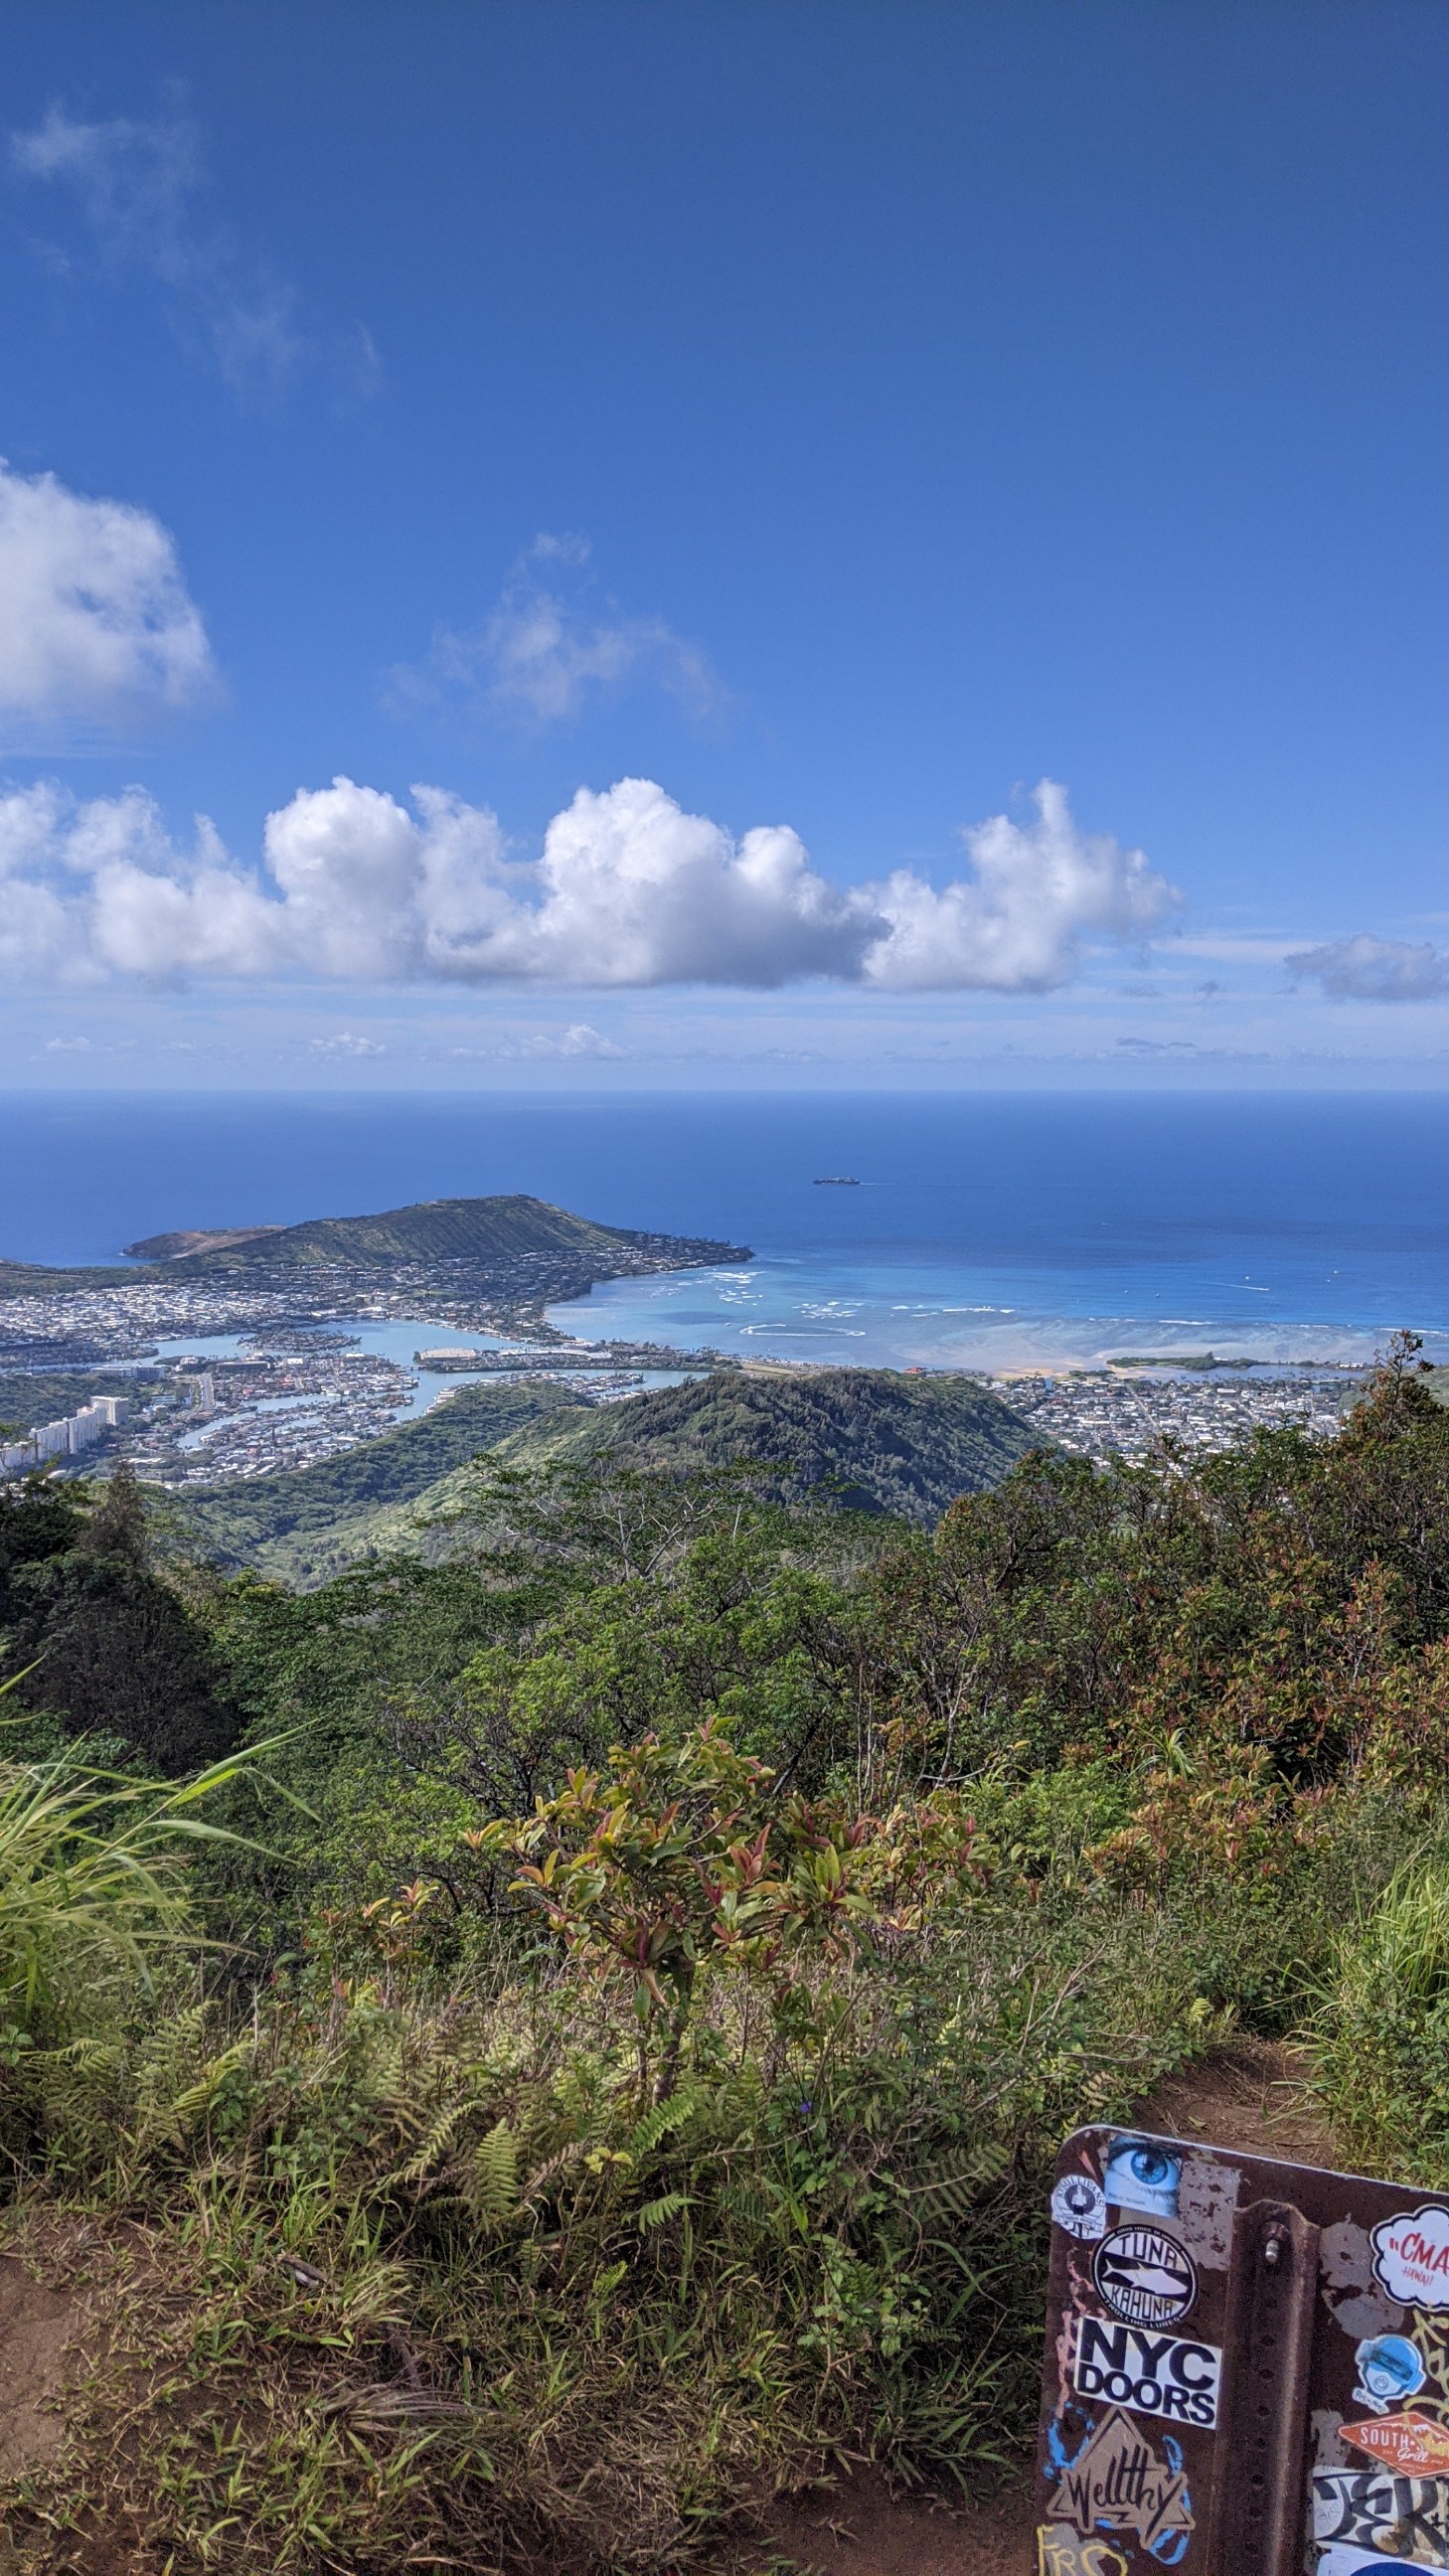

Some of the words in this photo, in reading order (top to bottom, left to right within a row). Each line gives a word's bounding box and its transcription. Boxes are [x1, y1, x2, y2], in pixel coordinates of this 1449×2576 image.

[1119, 2234, 1178, 2269] TUNA
[1111, 2286, 1173, 2320] KAHUNA
[1079, 2318, 1217, 2391] NYC
[1077, 2362, 1215, 2425] DOORS
